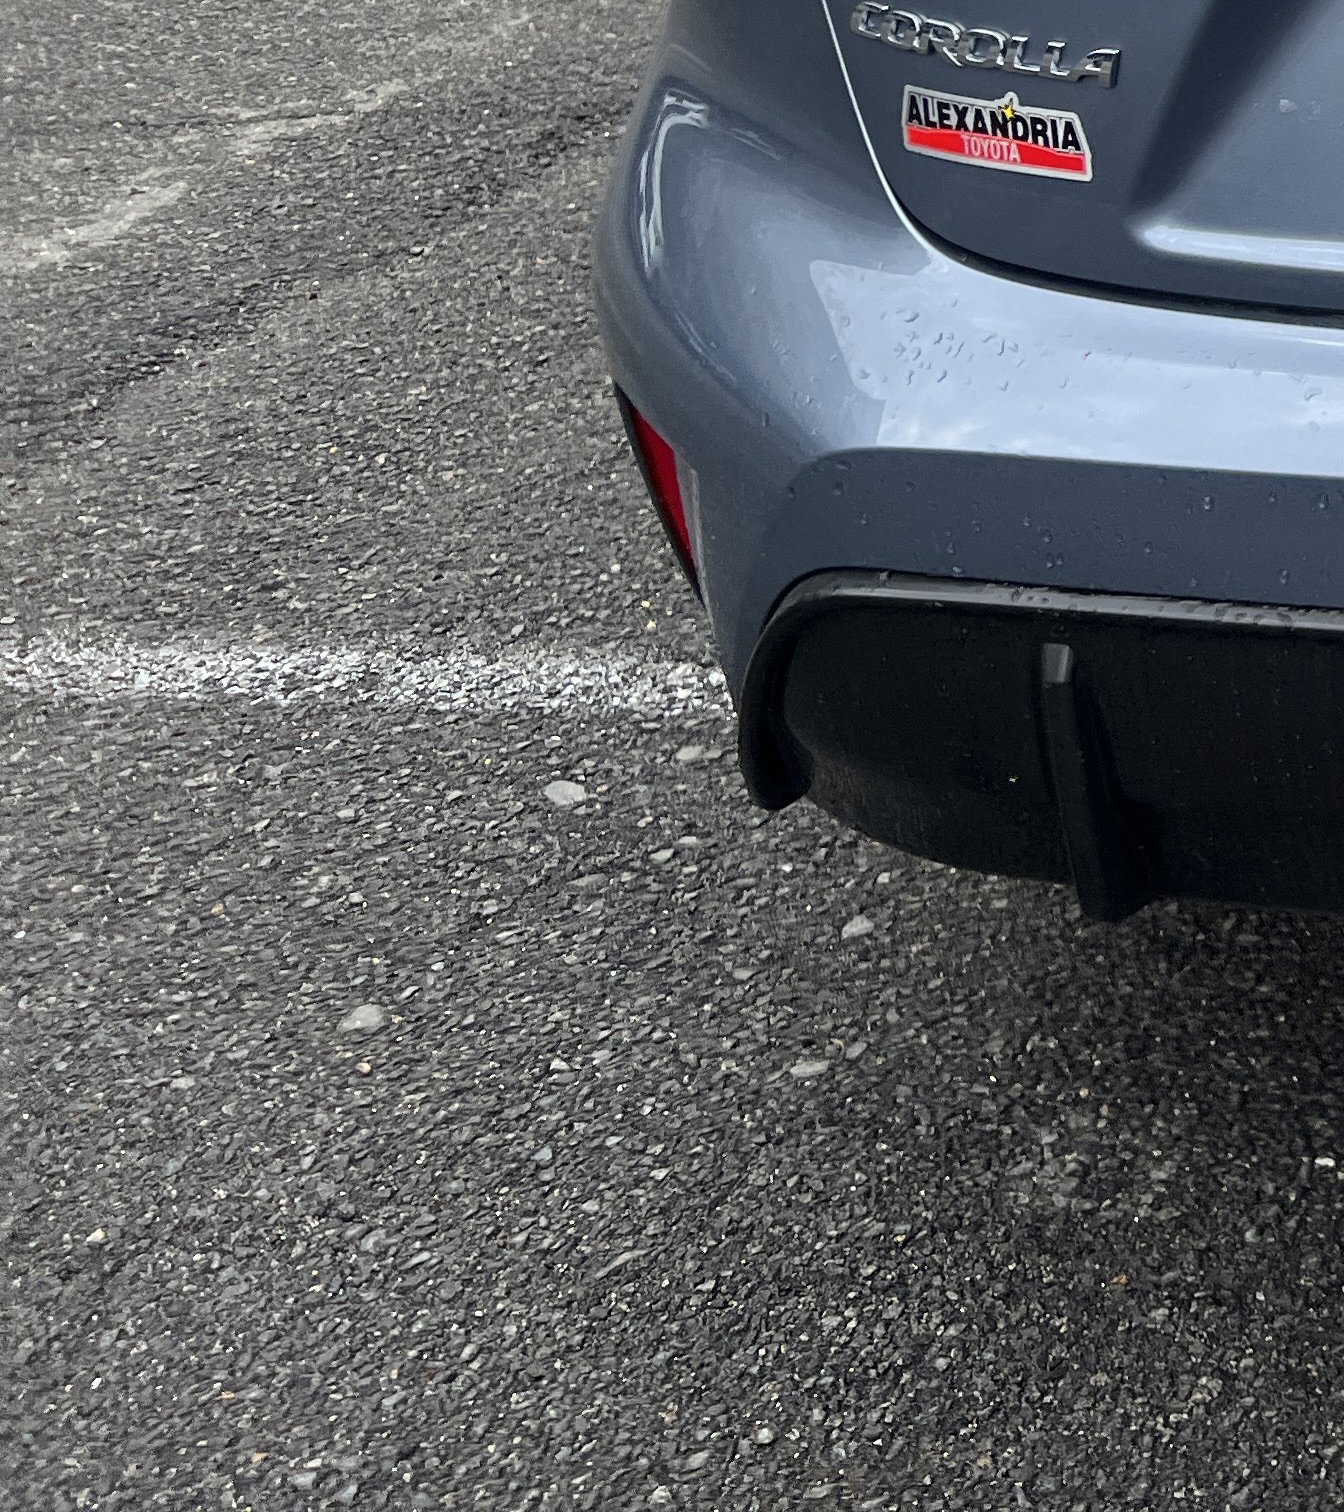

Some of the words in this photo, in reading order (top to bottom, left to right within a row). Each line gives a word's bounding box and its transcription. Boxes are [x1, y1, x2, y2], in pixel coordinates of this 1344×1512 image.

[851, 1, 1121, 88] COROLLA
[907, 94, 1082, 152] ALEXANDRIA
[963, 134, 1022, 163] TOYOTA
